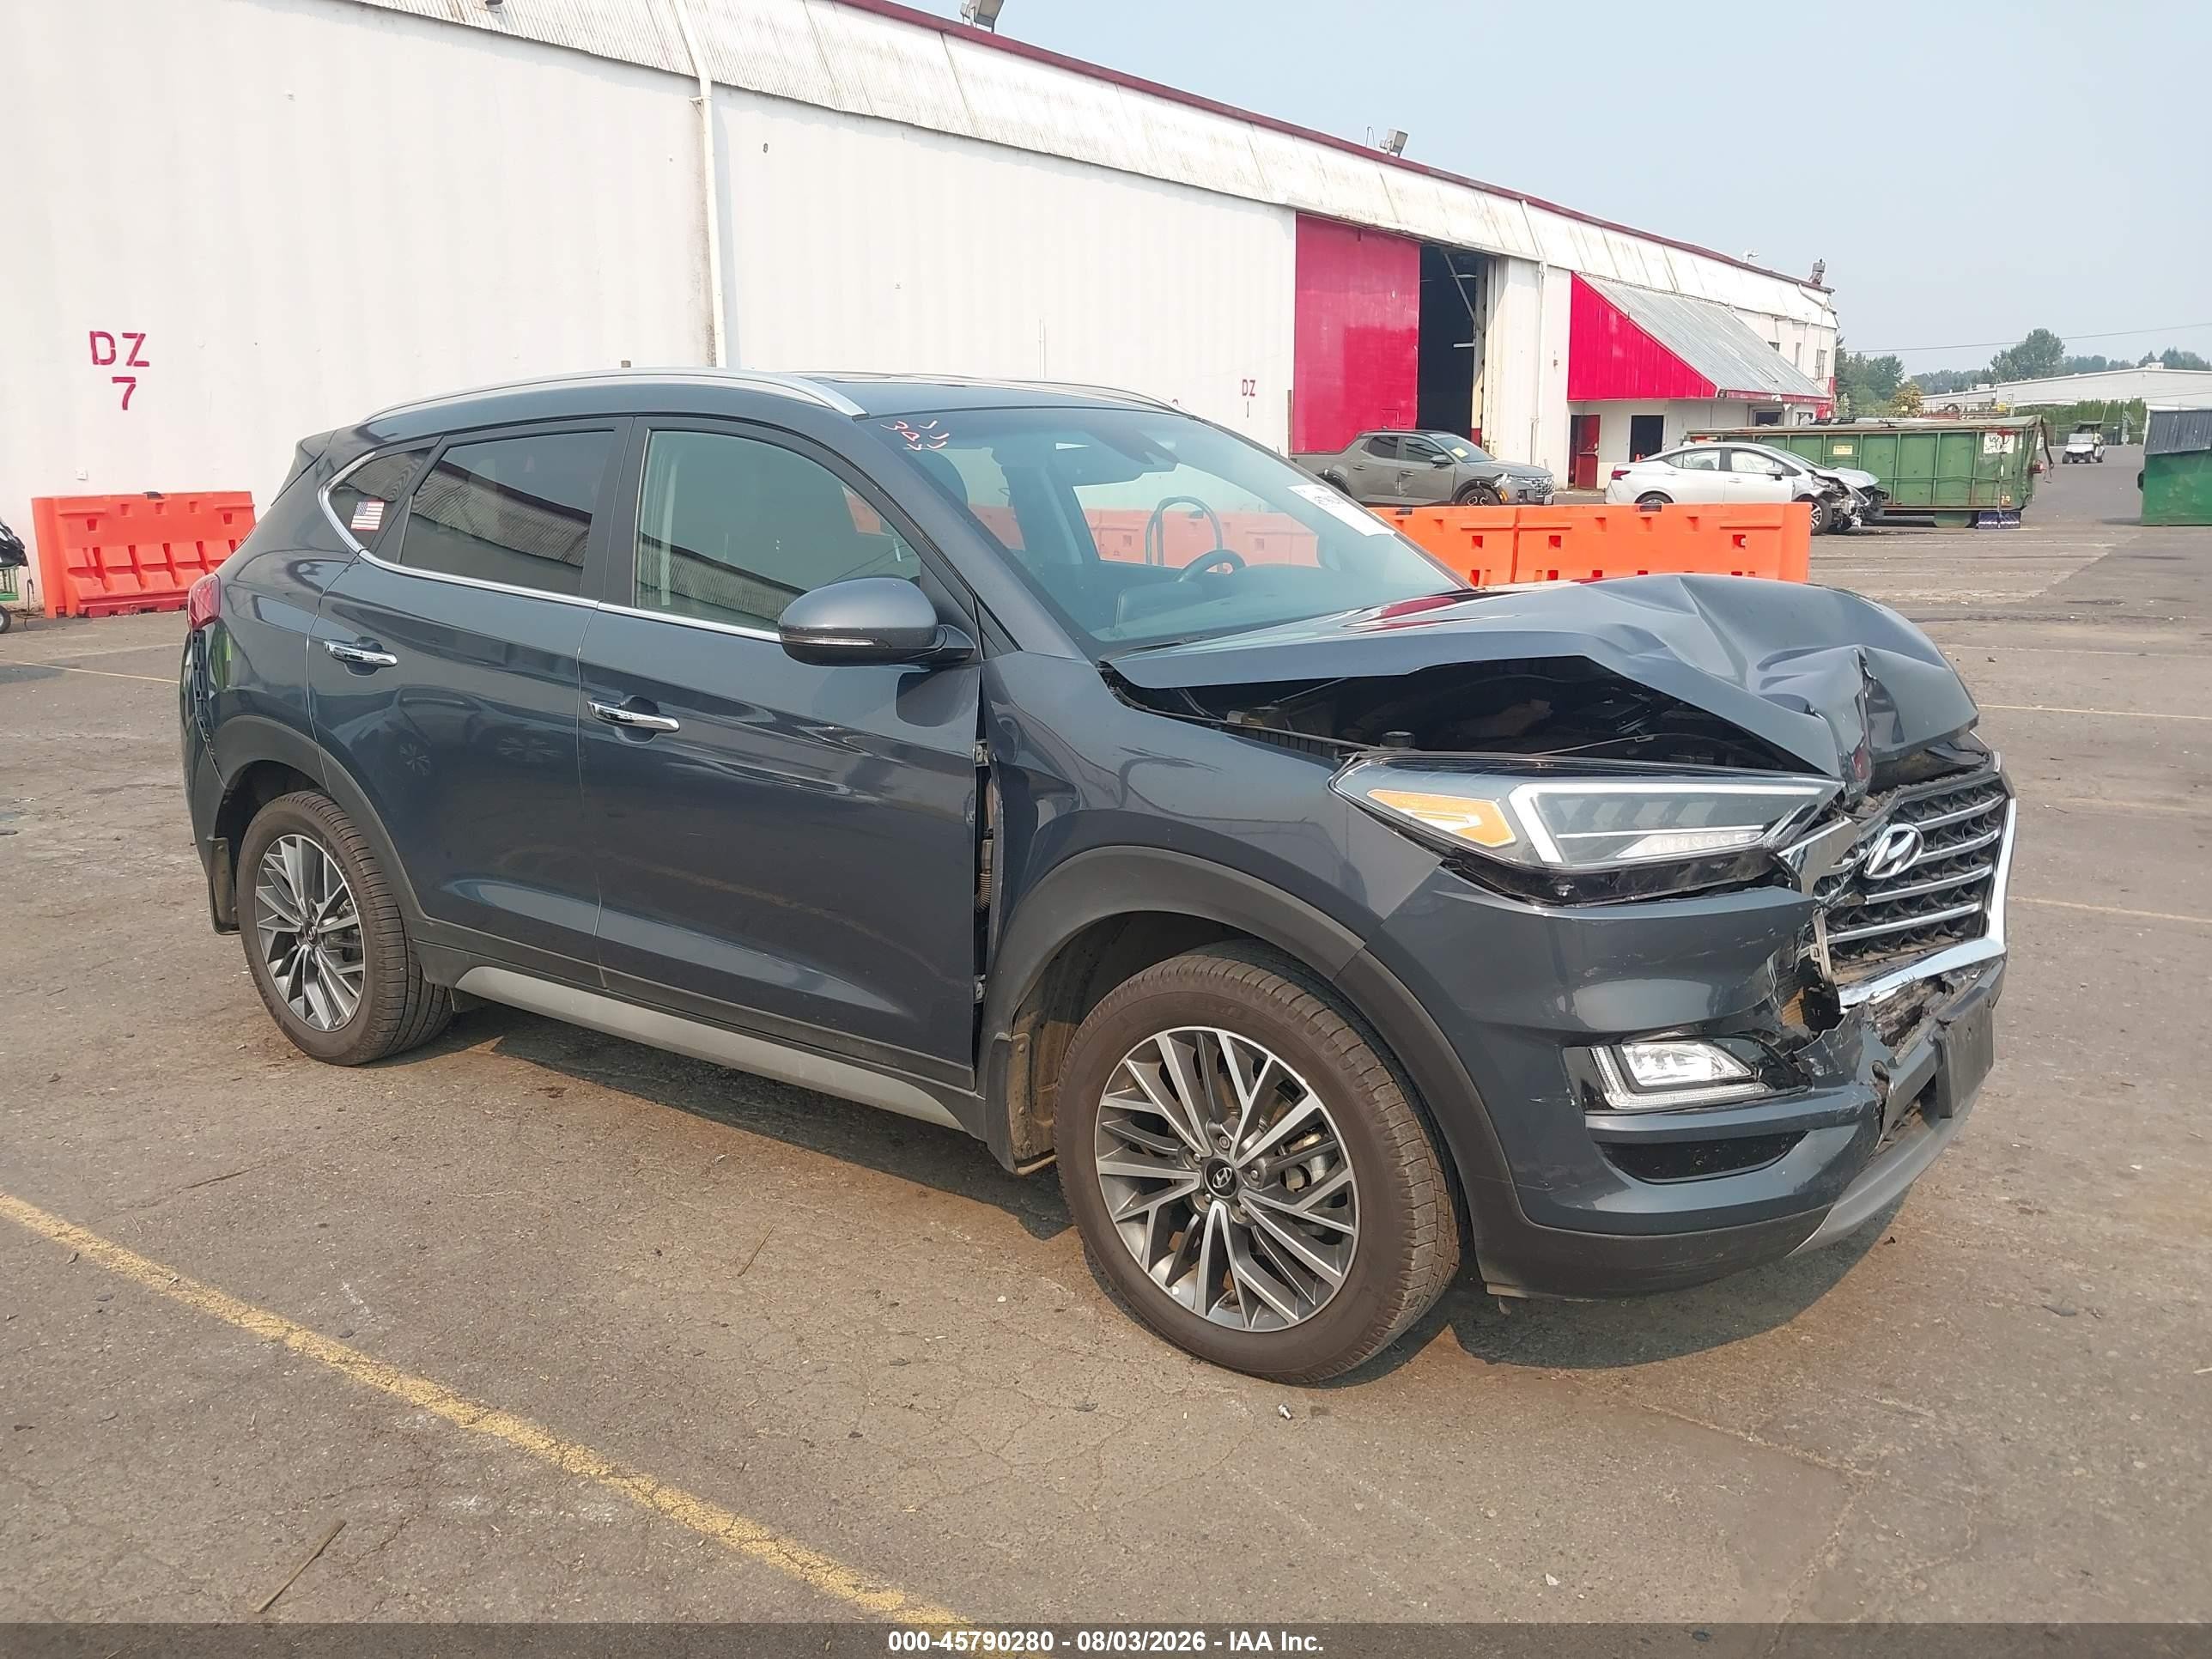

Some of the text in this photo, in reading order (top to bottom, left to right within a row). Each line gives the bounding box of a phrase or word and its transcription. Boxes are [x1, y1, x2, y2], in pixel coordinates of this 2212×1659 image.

[89, 331, 150, 368] DZ
[112, 376, 137, 410] 7
[1242, 379, 1256, 398] DZ
